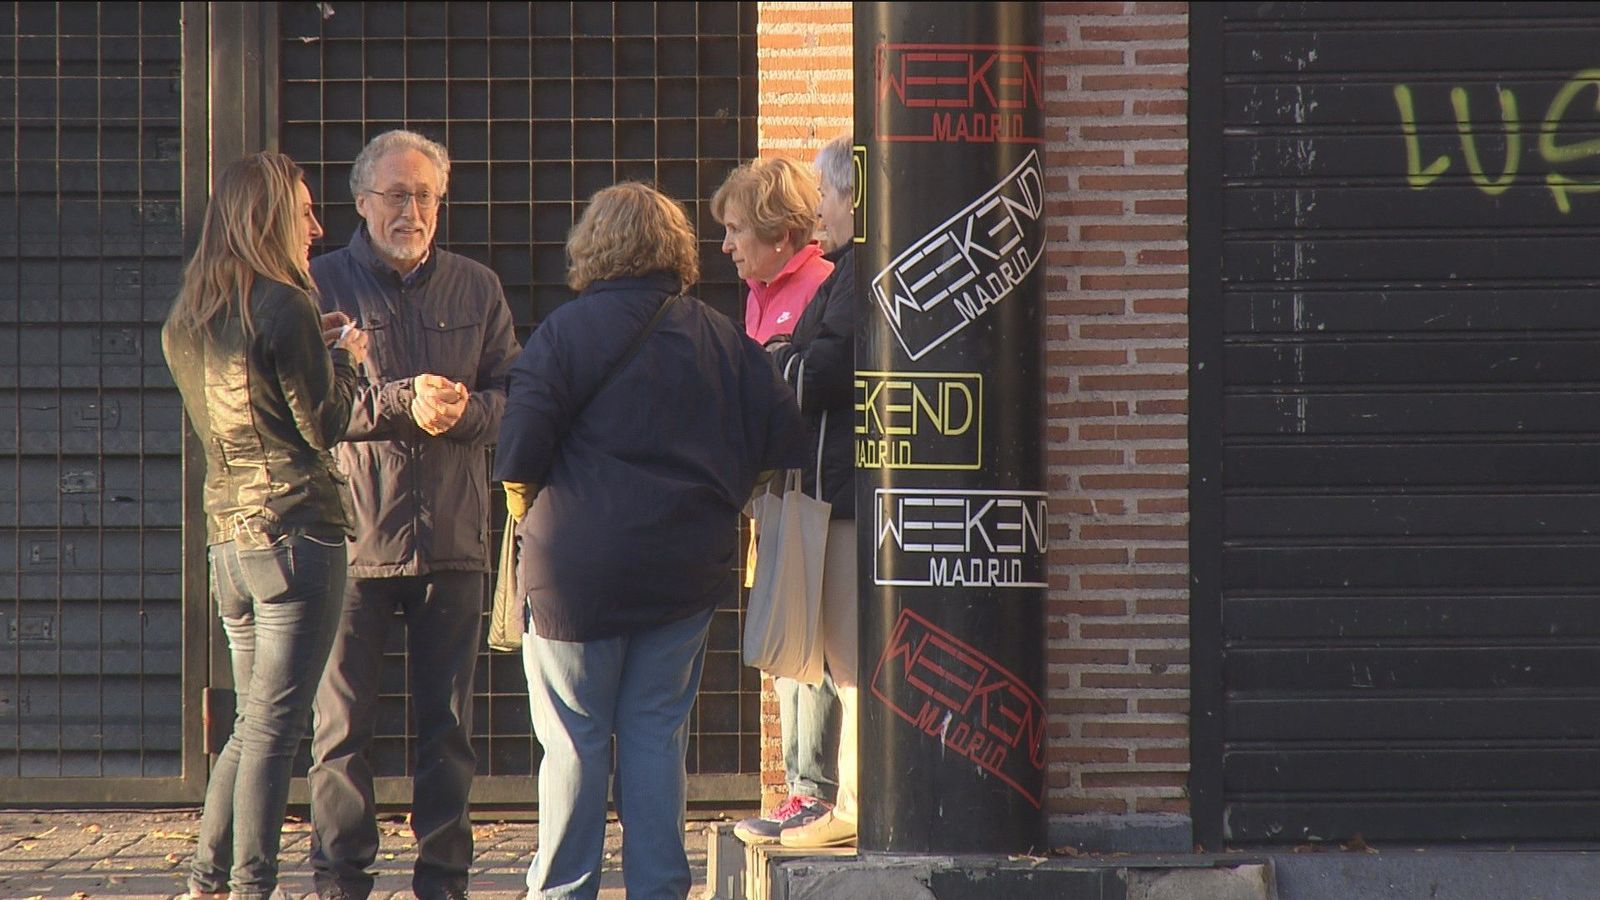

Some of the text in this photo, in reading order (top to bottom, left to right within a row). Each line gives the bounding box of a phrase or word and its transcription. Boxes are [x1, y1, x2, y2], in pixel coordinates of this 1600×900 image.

[880, 53, 1045, 111] WEEKEN
[933, 112, 1024, 142] MADRID
[878, 166, 1043, 329] WEEKEND
[954, 246, 1032, 321] MADRID
[878, 497, 1048, 553] WEEKEND
[930, 557, 1022, 586] MADRID
